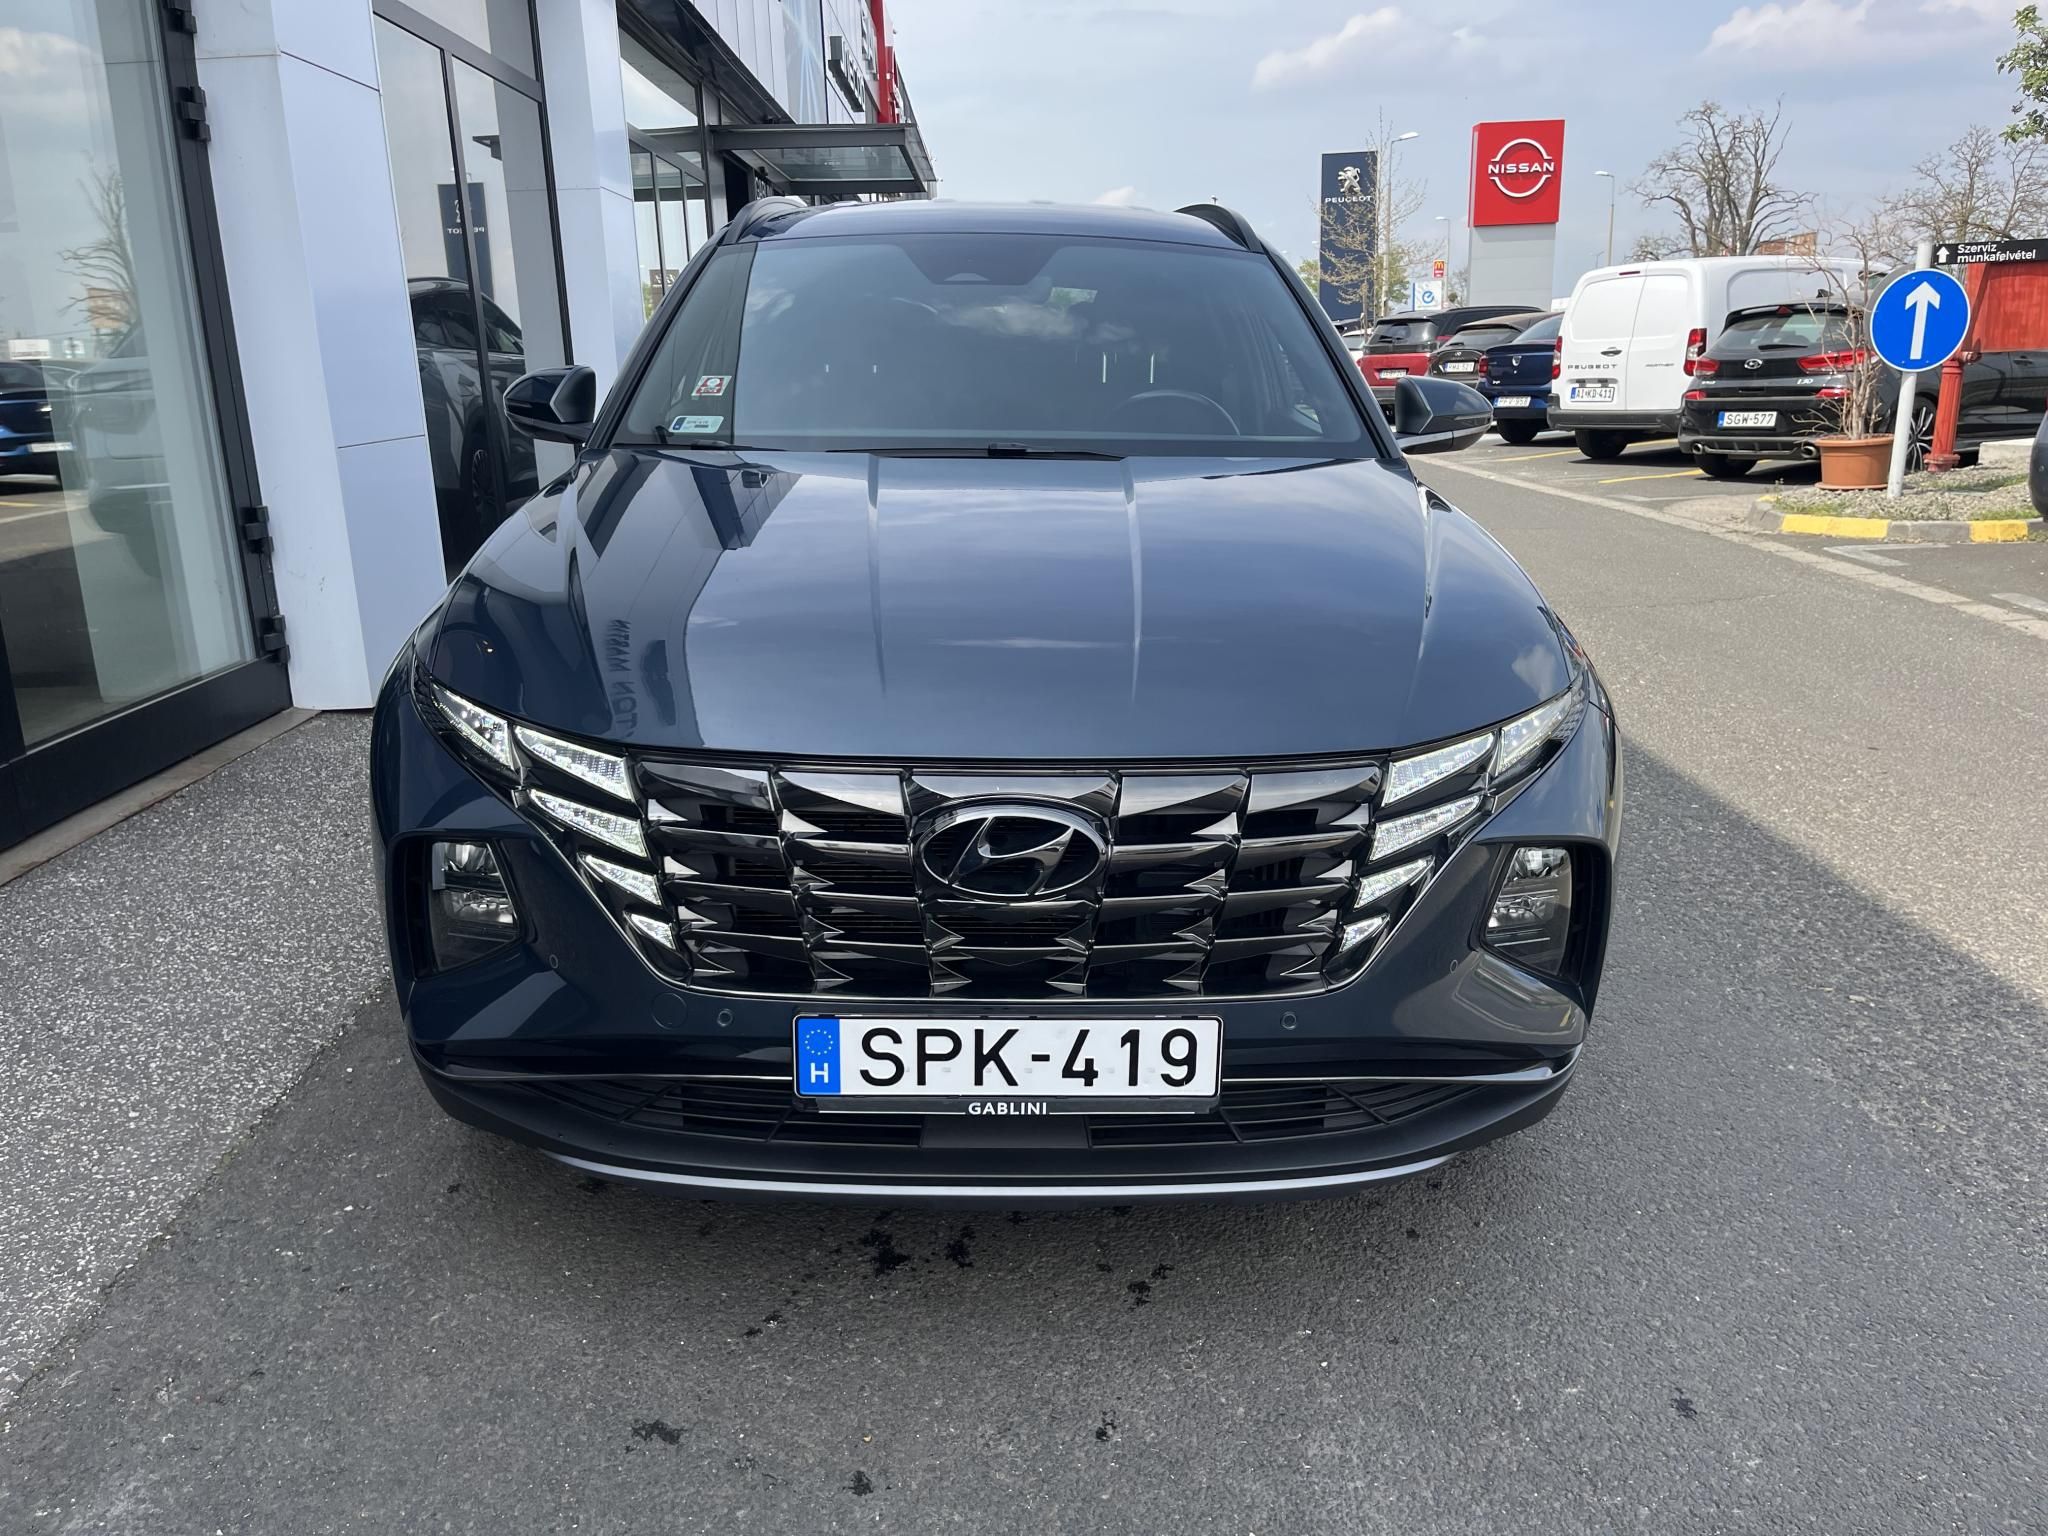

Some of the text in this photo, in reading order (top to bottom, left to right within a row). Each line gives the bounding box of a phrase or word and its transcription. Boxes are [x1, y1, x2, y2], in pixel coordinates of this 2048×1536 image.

[1488, 162, 1554, 174] NISSAN
[1957, 243, 1997, 253] Szerviz
[1957, 249, 2036, 263] munkafelvétel
[1726, 413, 1775, 425] SGW-577
[859, 1027, 1198, 1088] SPK-419
[809, 1062, 829, 1084] H
[968, 1101, 1048, 1116] GABLINI
